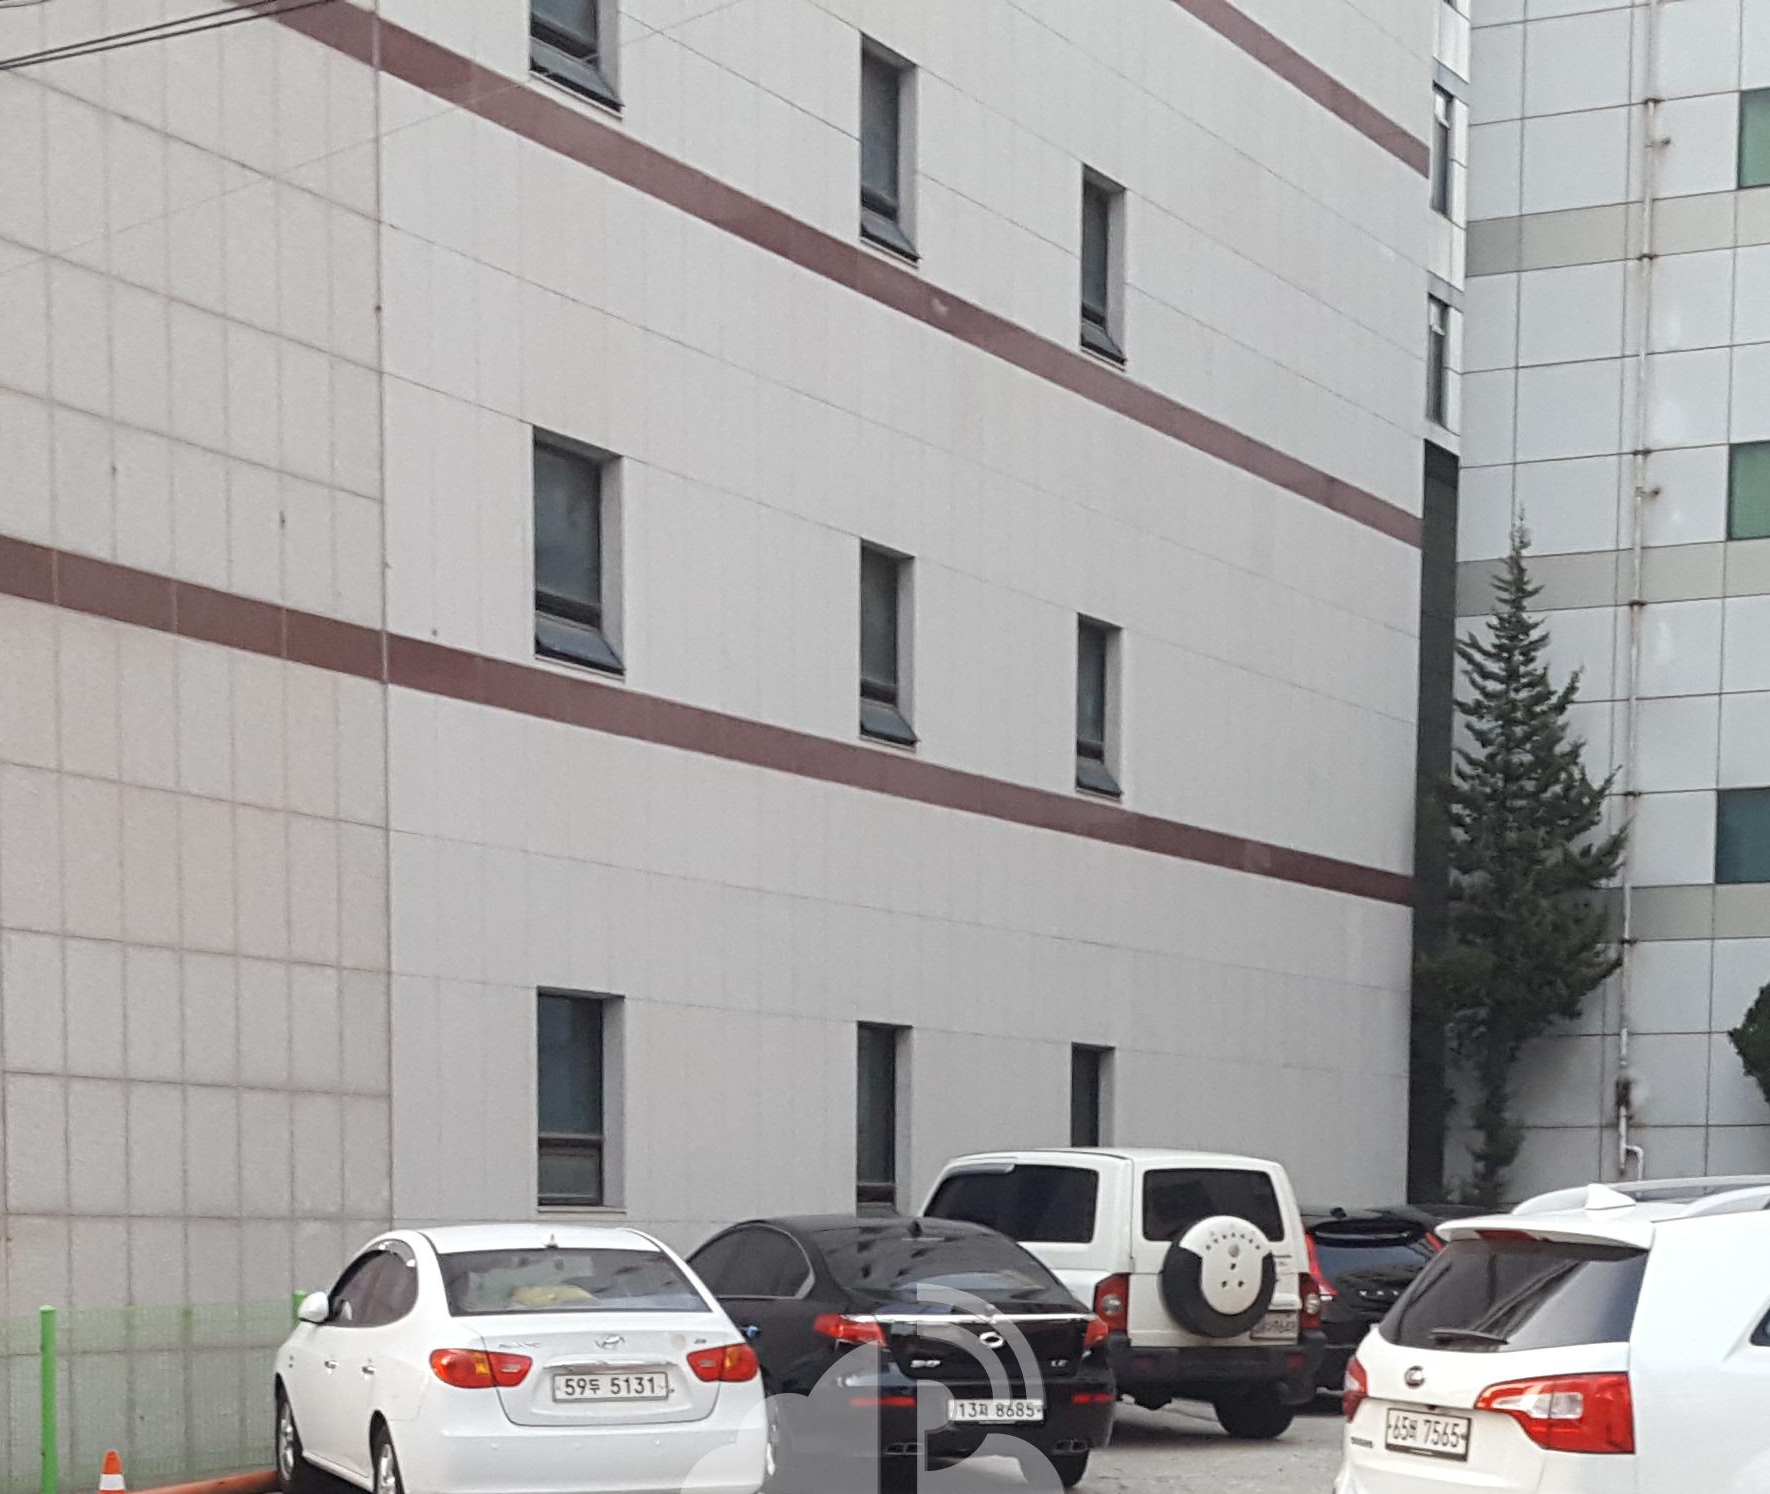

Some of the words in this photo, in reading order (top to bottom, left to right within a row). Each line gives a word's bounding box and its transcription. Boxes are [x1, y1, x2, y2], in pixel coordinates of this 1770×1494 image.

[610, 1376, 656, 1395] 5131
[995, 1402, 1035, 1418] 8685
[1423, 1419, 1461, 1449] 7565
